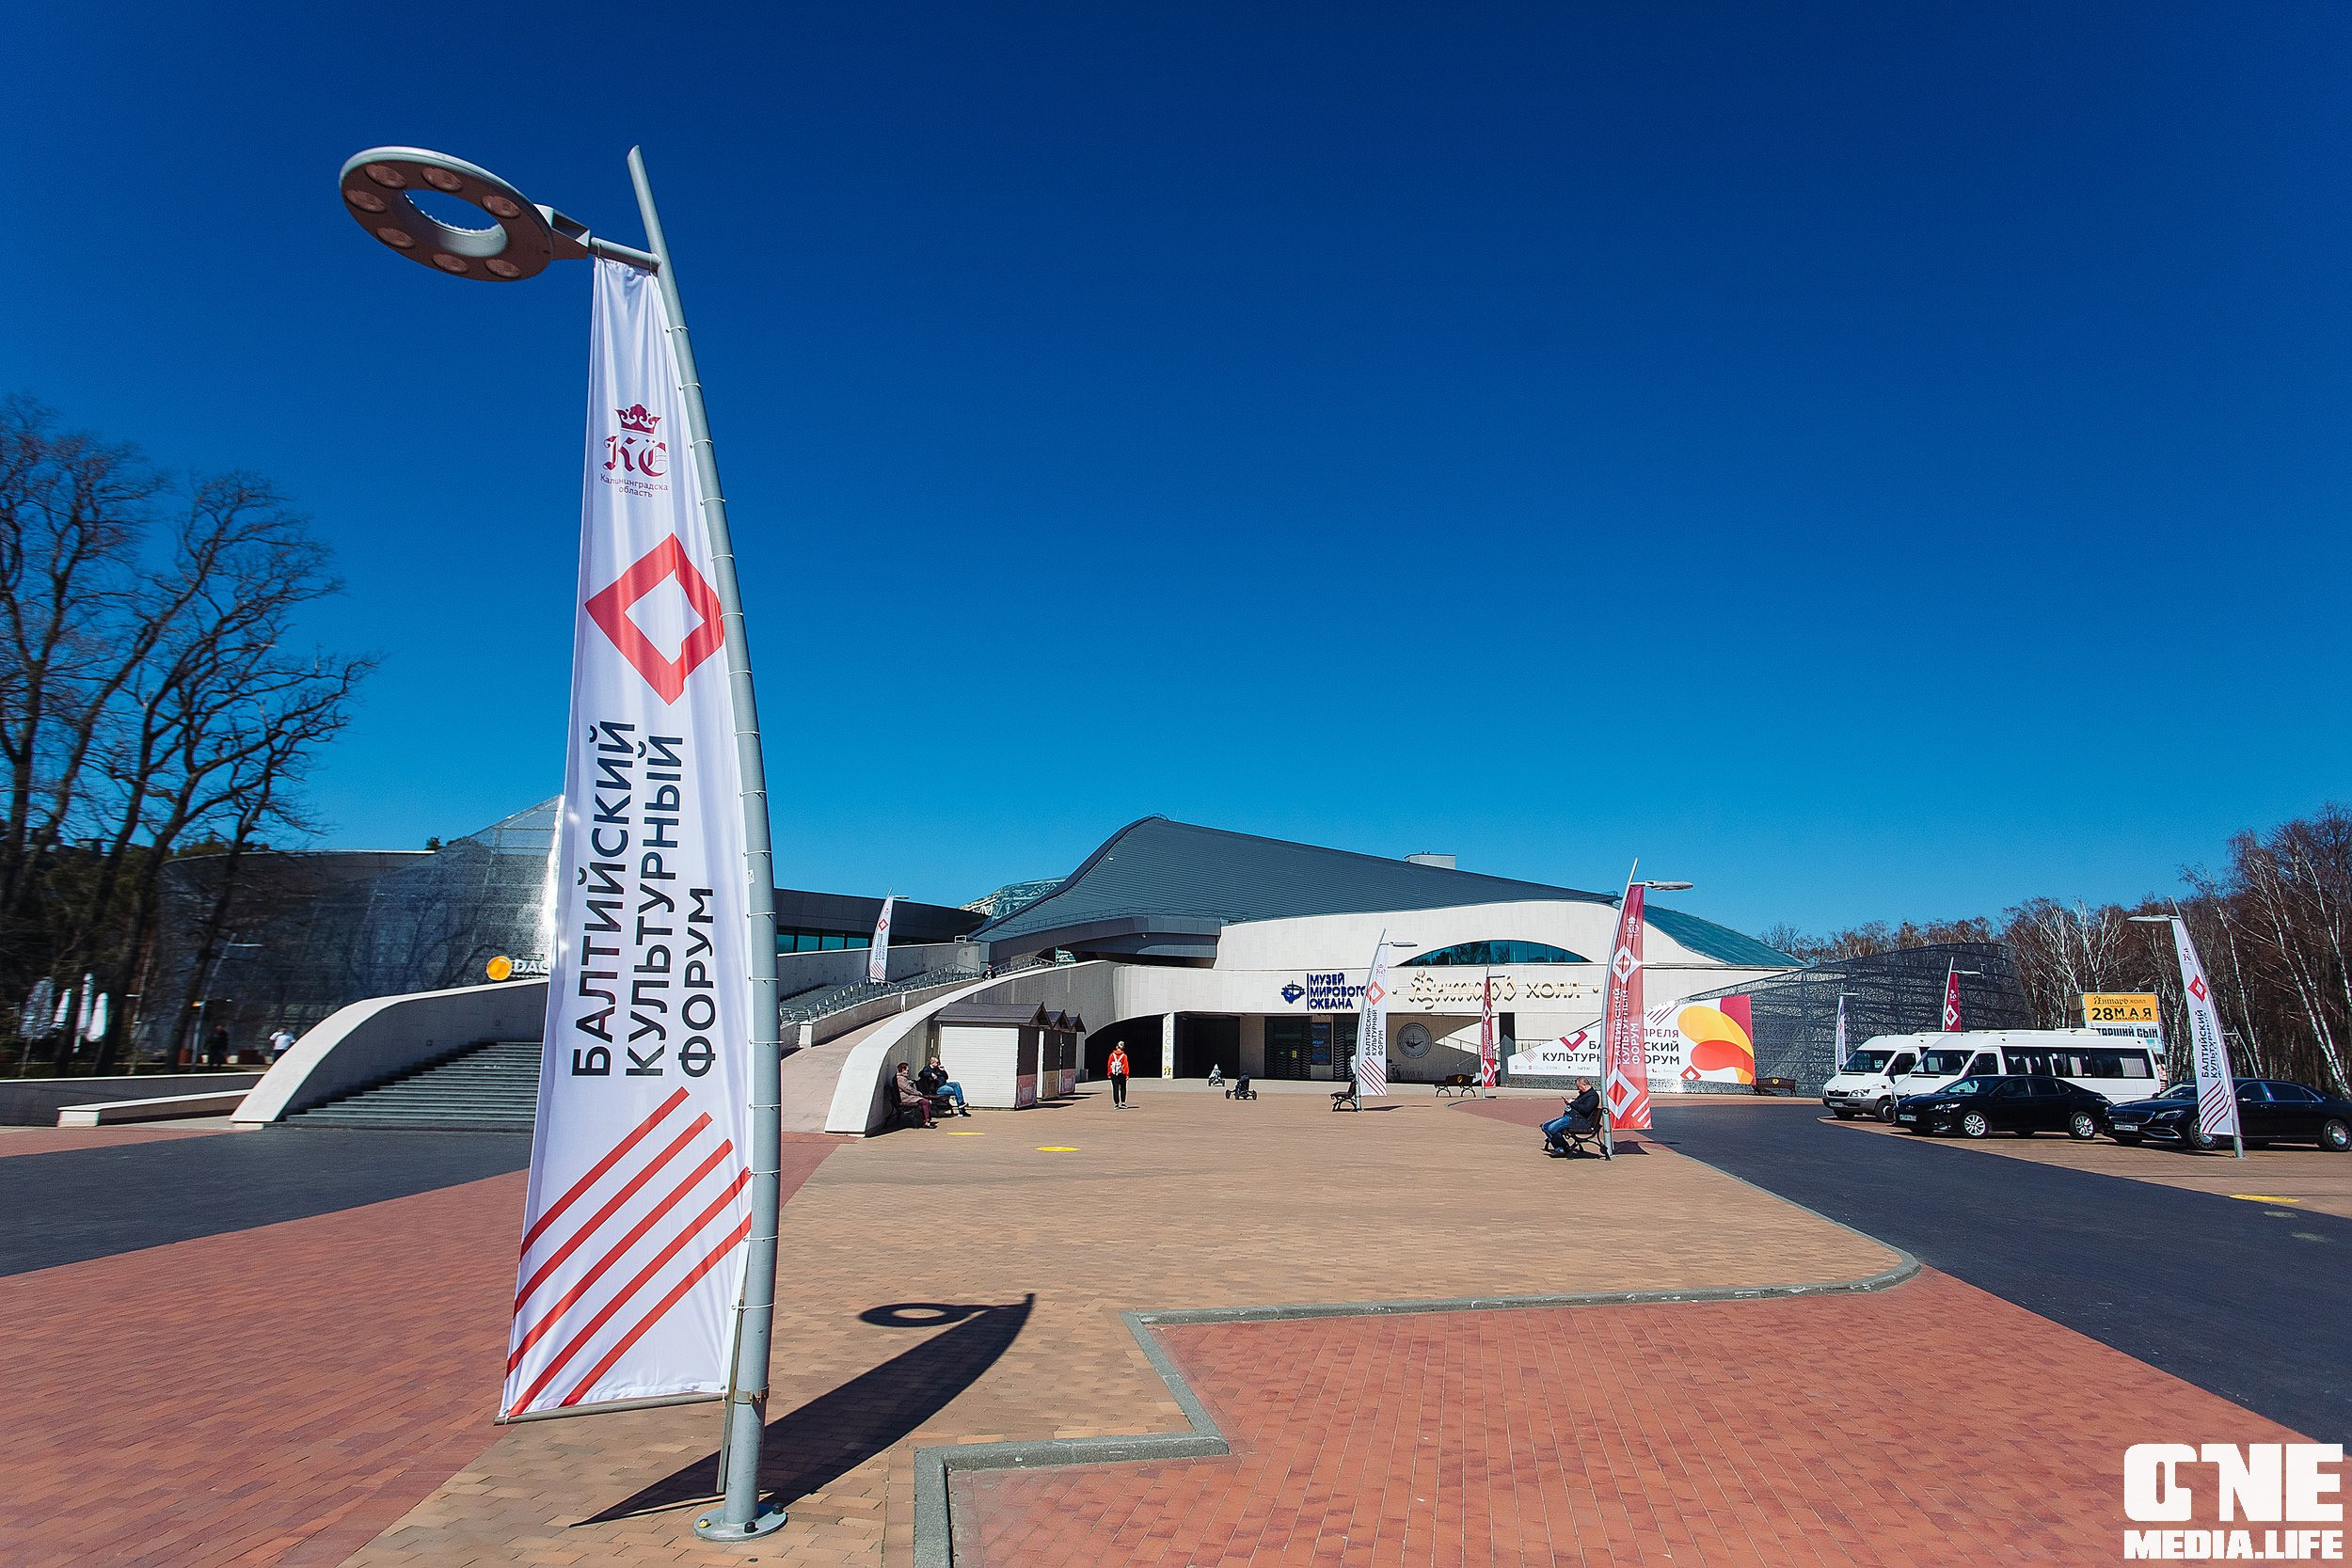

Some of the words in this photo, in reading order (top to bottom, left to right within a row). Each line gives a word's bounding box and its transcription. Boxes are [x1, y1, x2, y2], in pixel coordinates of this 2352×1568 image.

[600, 473, 669, 491] Калининградска
[618, 485, 653, 499] область
[571, 720, 636, 1077] БАЛТИЙСКИЙ
[625, 735, 684, 1077] КУЛЬТУРНЫЙ
[677, 887, 717, 1078] ФОРУМ
[1310, 972, 1344, 986] МУЗЕЙ
[1526, 982, 1581, 999] холл
[1310, 998, 1353, 1010] ОКЕАНА
[2091, 1007, 2114, 1021] 28
[2114, 1007, 2153, 1017] МАЯ
[2137, 1027, 2159, 1038] СЫН
[1630, 1022, 1641, 1065] ФОРУМ
[2195, 1009, 2210, 1079] БАЛТИЙСКИЙ
